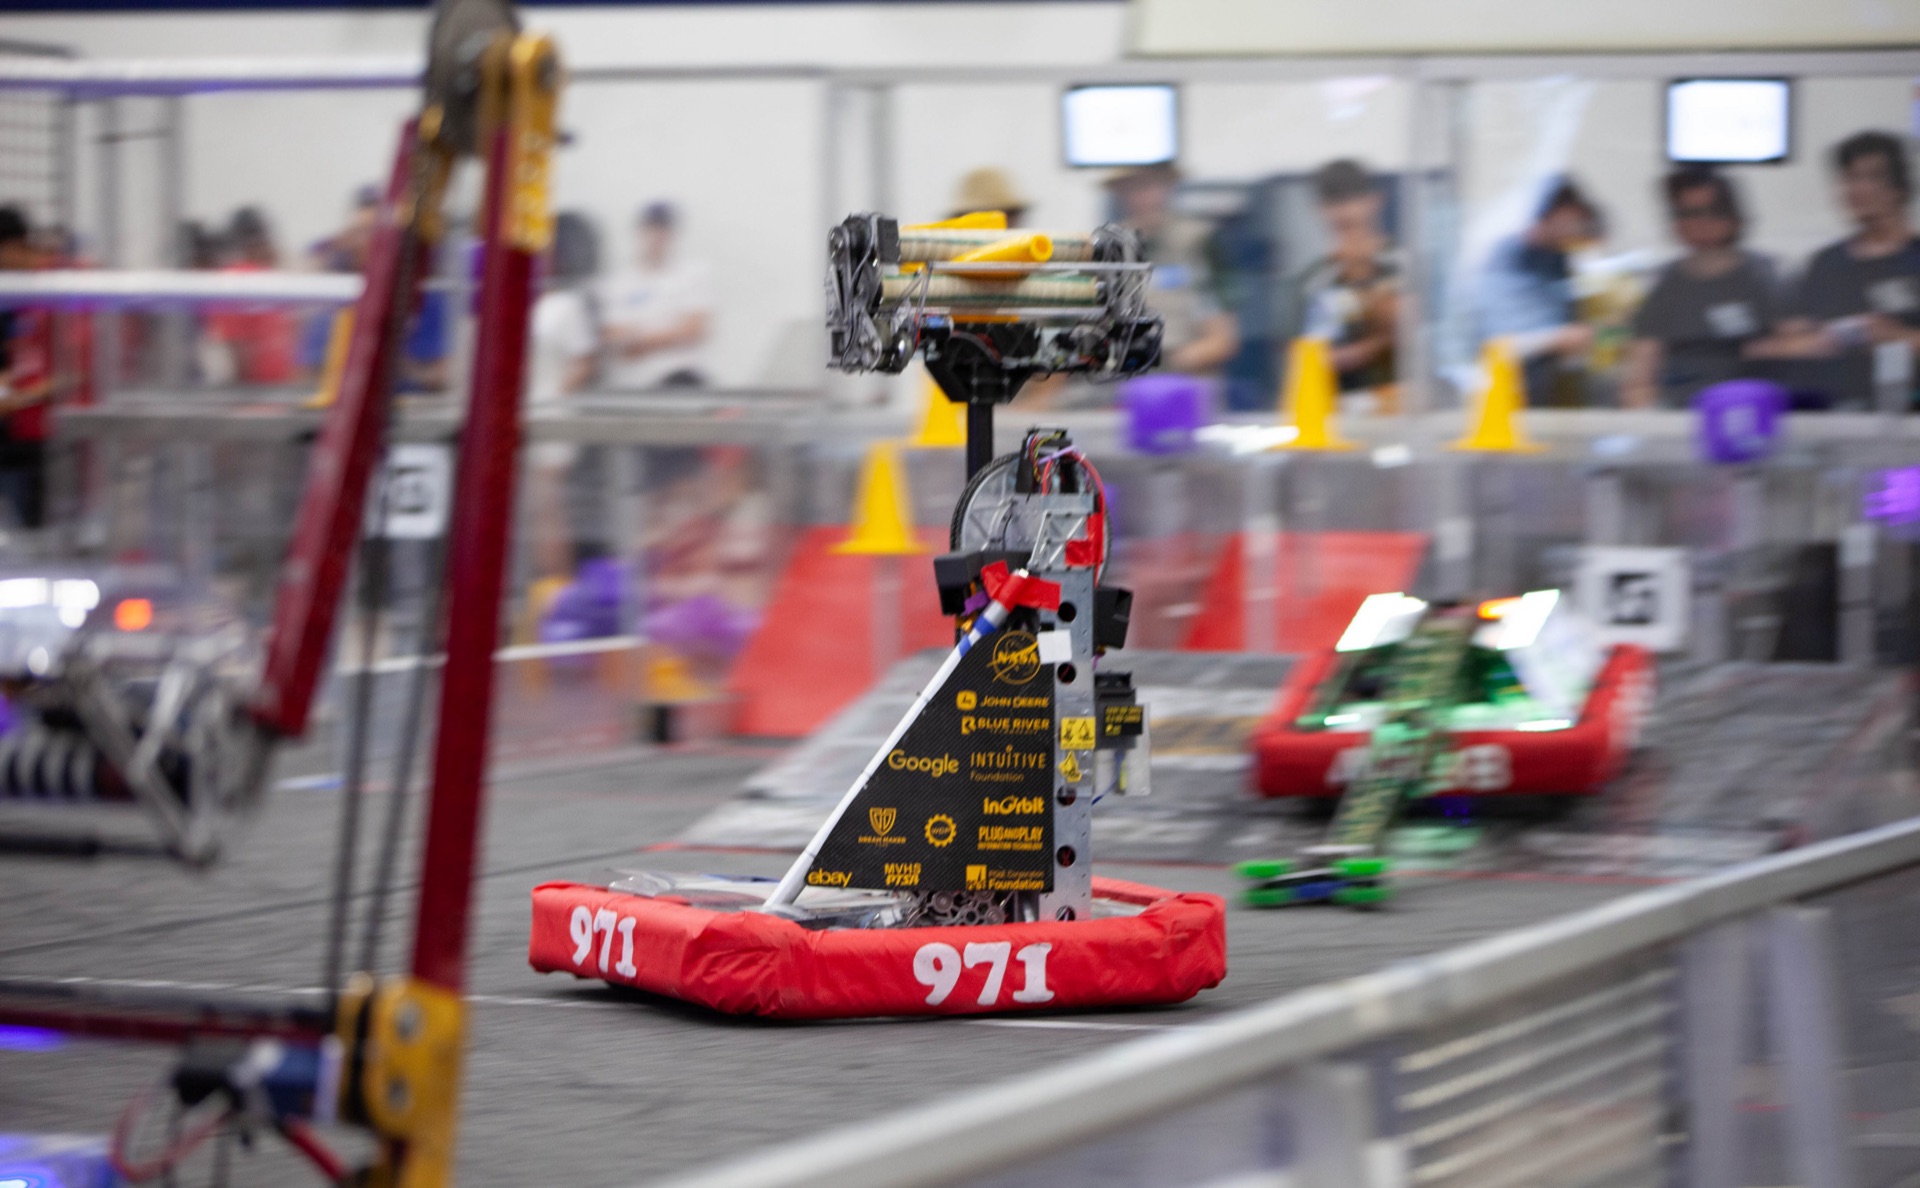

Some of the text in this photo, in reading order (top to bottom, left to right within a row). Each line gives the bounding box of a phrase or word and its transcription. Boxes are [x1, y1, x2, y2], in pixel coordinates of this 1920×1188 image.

[997, 651, 1039, 665] NASA
[981, 696, 1049, 708] JOHN DEERE
[978, 717, 1050, 730] BLUE RIVER
[888, 749, 959, 778] Google
[970, 745, 1047, 769] INTUITIVE
[970, 771, 1024, 783] Foundation
[983, 795, 1045, 815] InOrbit
[884, 862, 922, 875] MVHS
[808, 868, 853, 888] ebay
[885, 874, 920, 886] PTSA
[988, 880, 1045, 891] Foundation
[569, 905, 637, 978] 971
[913, 942, 1055, 1006] 971
